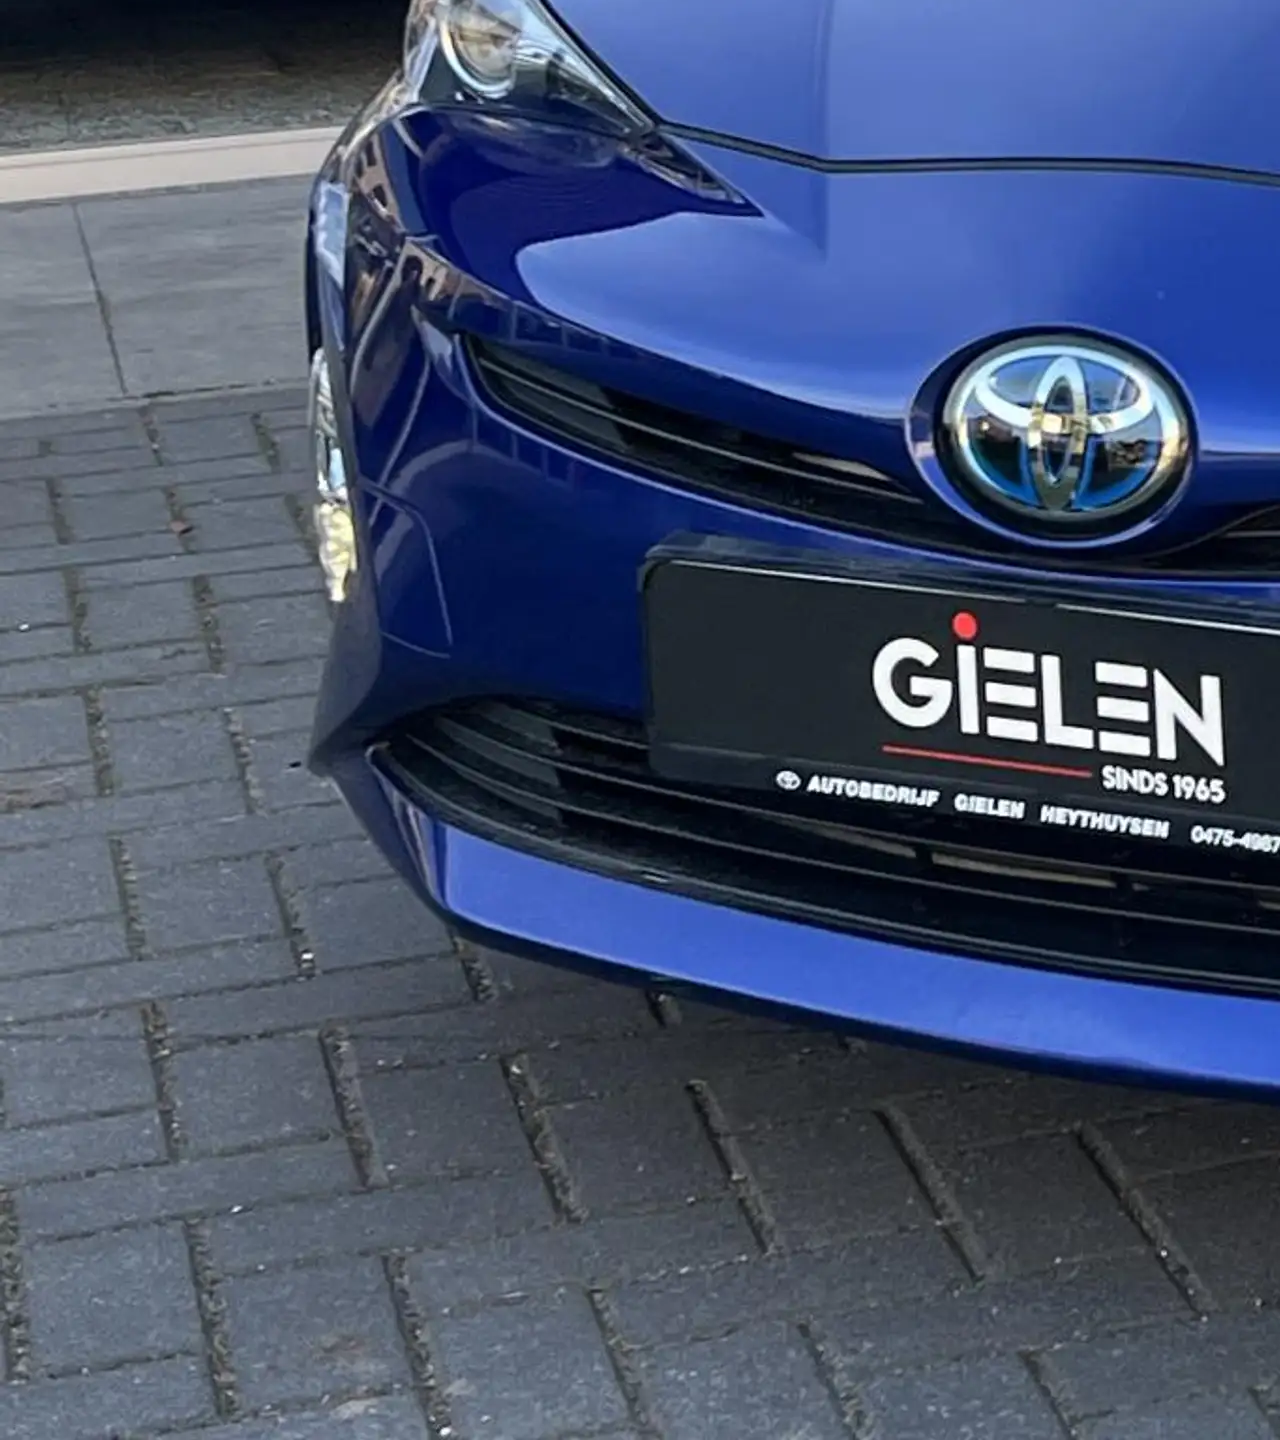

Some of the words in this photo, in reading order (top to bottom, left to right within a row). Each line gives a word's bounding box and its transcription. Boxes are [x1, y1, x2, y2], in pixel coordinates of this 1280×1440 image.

[806, 775, 940, 808] AUTOBEDRIJF
[954, 793, 1025, 819] GIELEN
[1040, 804, 1170, 839] HEYTHUYSEN
[1102, 764, 1169, 796] SINDS
[1171, 774, 1226, 804] 1965
